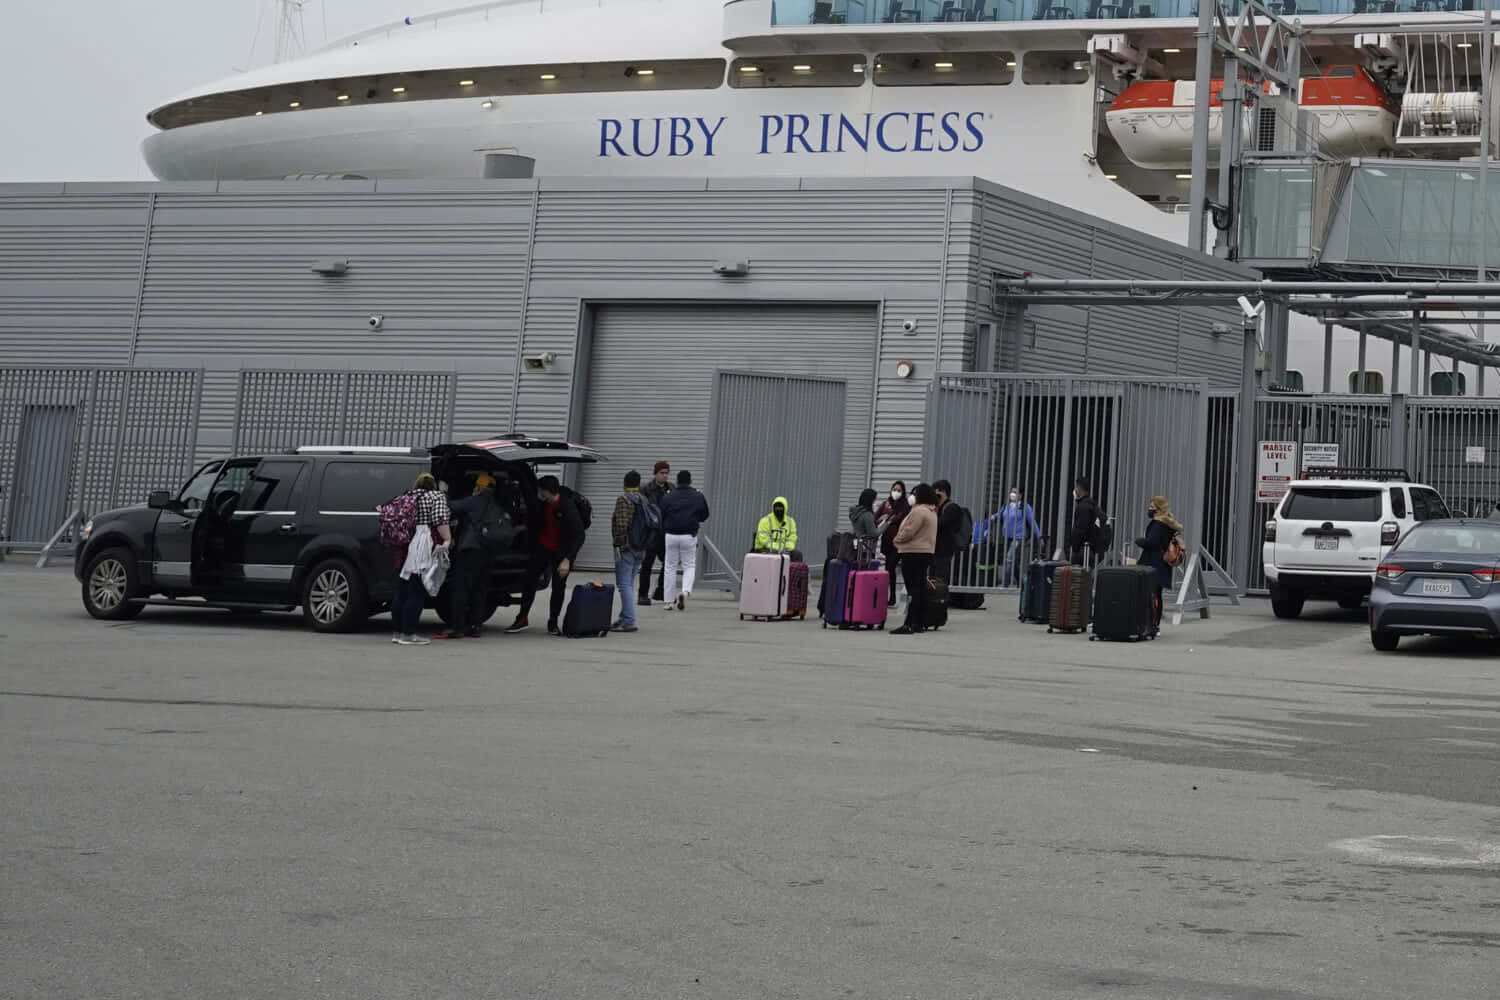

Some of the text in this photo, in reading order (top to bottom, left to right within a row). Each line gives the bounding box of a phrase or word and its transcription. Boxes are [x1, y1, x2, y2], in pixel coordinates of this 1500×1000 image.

[598, 111, 987, 158] RUBY PRINCESS
[1263, 444, 1293, 452] MARSEC
[1266, 452, 1287, 460] LEVEL
